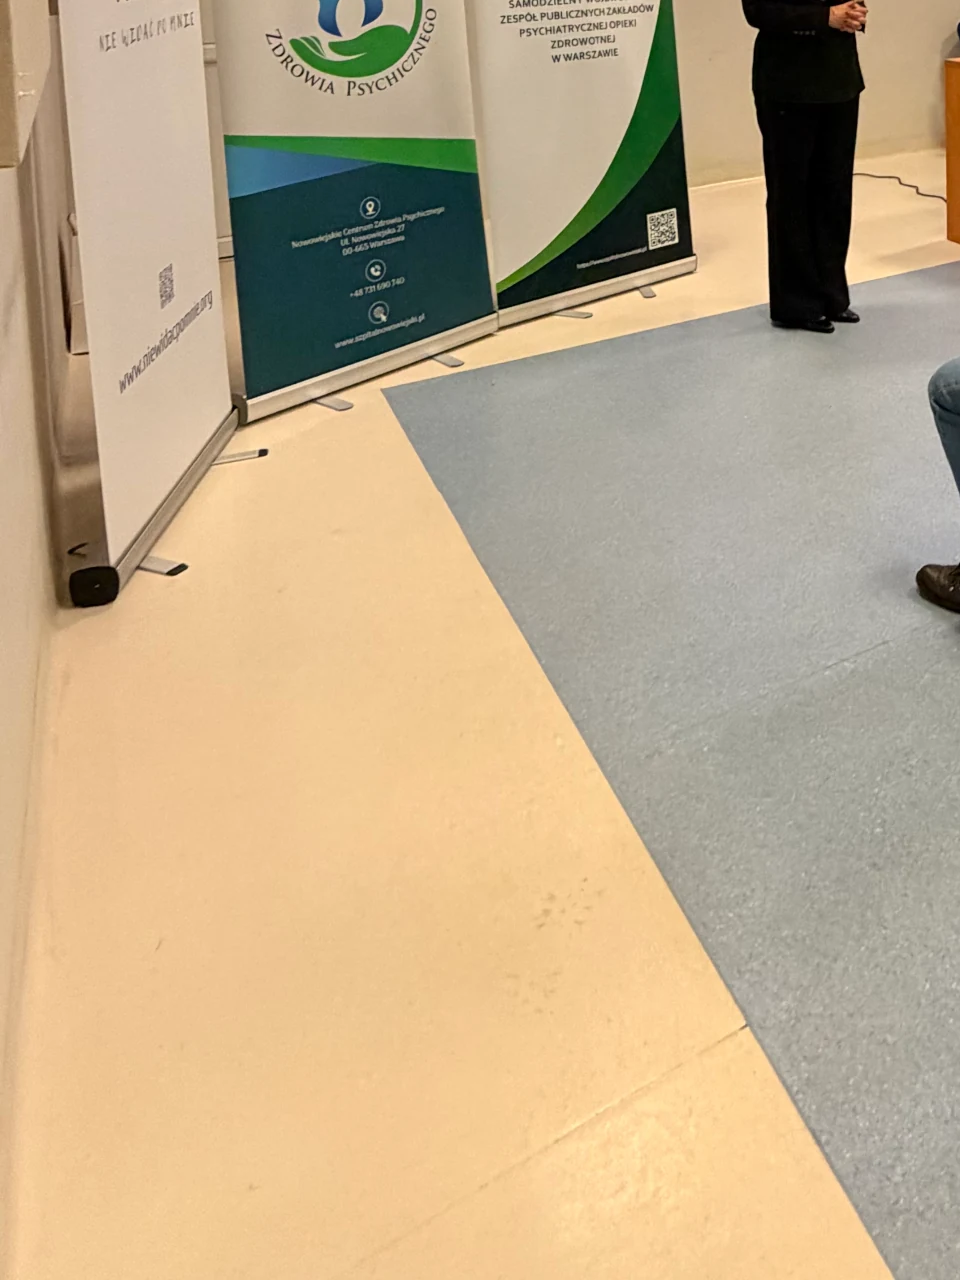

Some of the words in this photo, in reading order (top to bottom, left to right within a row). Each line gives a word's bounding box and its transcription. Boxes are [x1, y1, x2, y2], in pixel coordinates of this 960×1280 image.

[500, 12, 539, 24] ZESPÓŁ
[540, 7, 605, 21] PUBLICZNYCH
[606, 4, 654, 16] ZAKŁADÓW
[519, 21, 608, 38] PSYCHIATRYCZNEJ
[609, 19, 637, 29] OPIEKI
[551, 34, 616, 49] ZDROWOTNEJ
[265, 28, 335, 95] ZDROWIA
[346, 8, 437, 96] PSYCHICZNEGO
[552, 54, 562, 63] W
[563, 48, 619, 62] WARSZAWIE
[343, 223, 373, 236] Centrum
